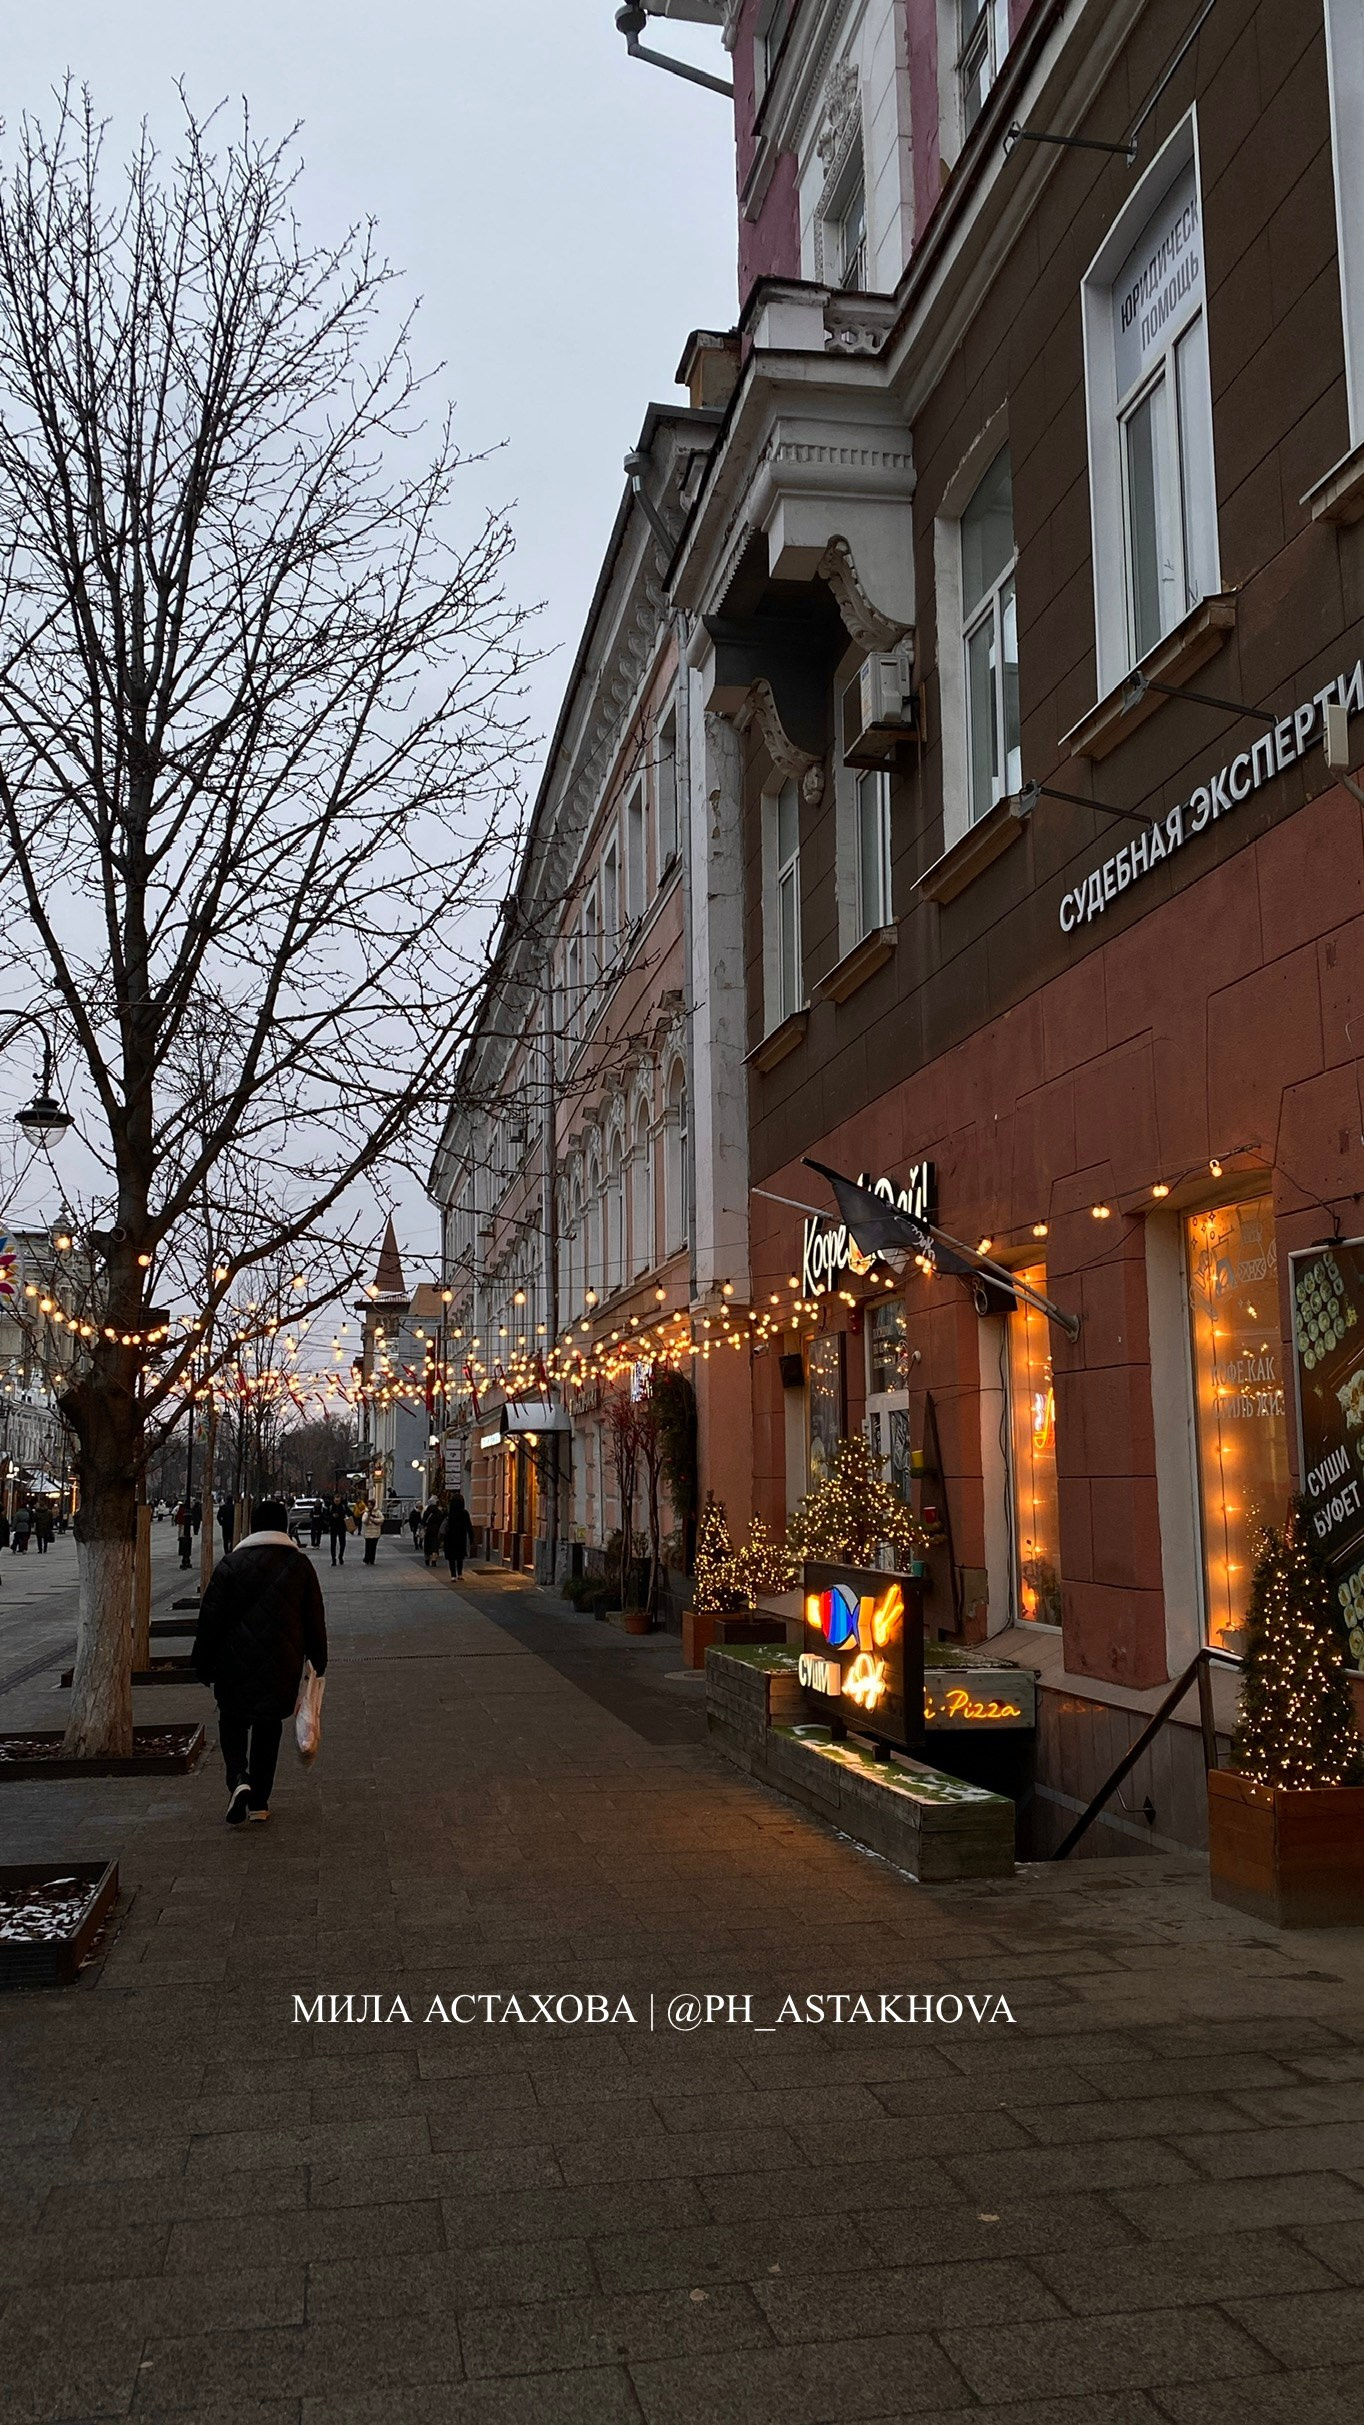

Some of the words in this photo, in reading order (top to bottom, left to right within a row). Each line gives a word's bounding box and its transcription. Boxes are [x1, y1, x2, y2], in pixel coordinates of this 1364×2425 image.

[1121, 198, 1199, 333] ЮРИДИЧЕСК
[1142, 250, 1199, 351] ПОМОЩЬ
[1059, 804, 1185, 933] СУДЕБНАЯ
[1189, 659, 1364, 832] ЭКСПЕРТИ
[802, 1215, 850, 1299] Кофе
[1211, 1361, 1244, 1387] КОФЕ
[1247, 1356, 1276, 1383] КАК
[1213, 1394, 1254, 1419] СТИЛЬ
[1307, 1444, 1351, 1497] СУШИ
[1313, 1480, 1361, 1538] БУФЕТ
[799, 1653, 838, 1696] СУШИ
[945, 1689, 1021, 1719] Pizza
